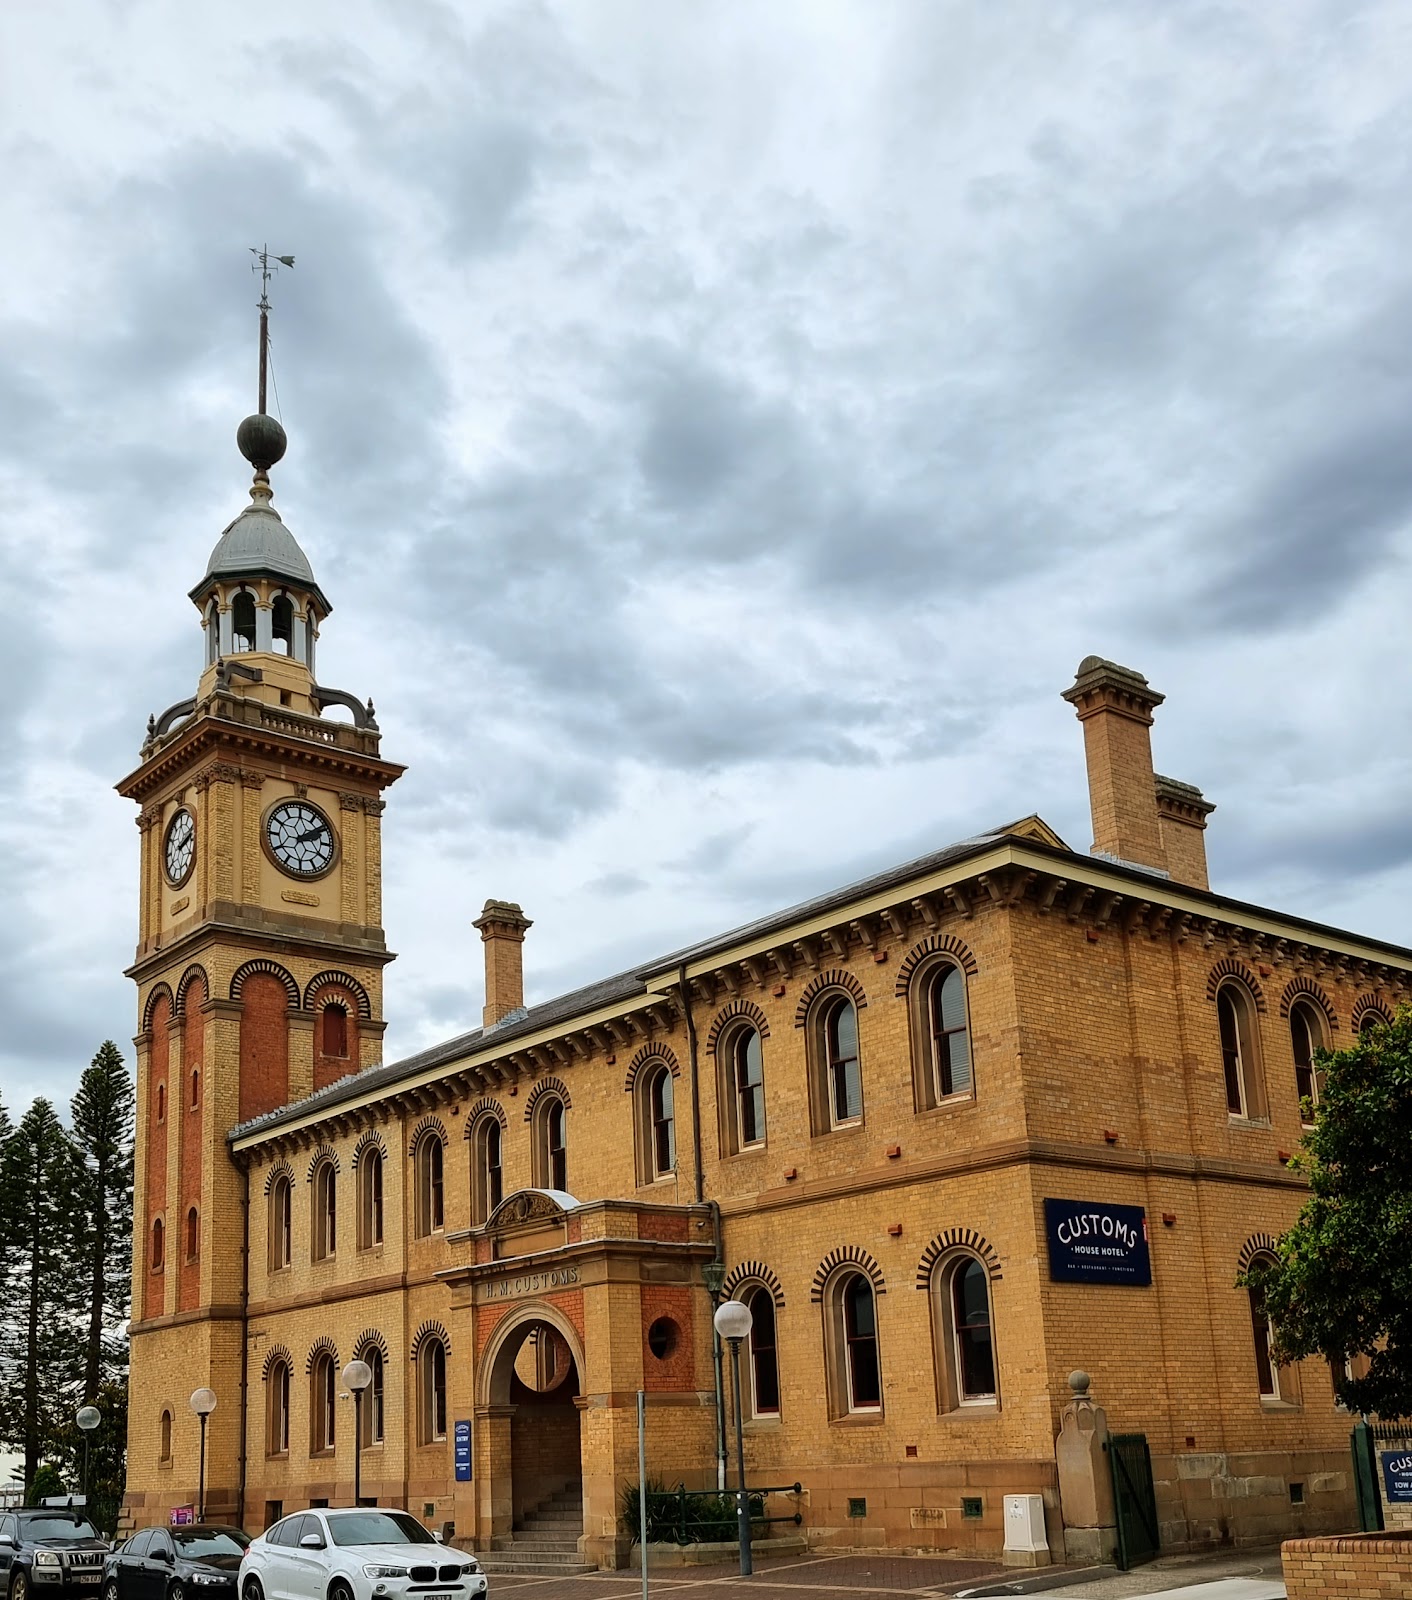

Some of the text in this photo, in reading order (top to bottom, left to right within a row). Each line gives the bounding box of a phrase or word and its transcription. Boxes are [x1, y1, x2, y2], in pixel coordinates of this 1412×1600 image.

[1057, 1214, 1137, 1248] CUSTOMS
[1074, 1245, 1125, 1257] HOUSE HOTEL
[1389, 1456, 1412, 1473] CUS
